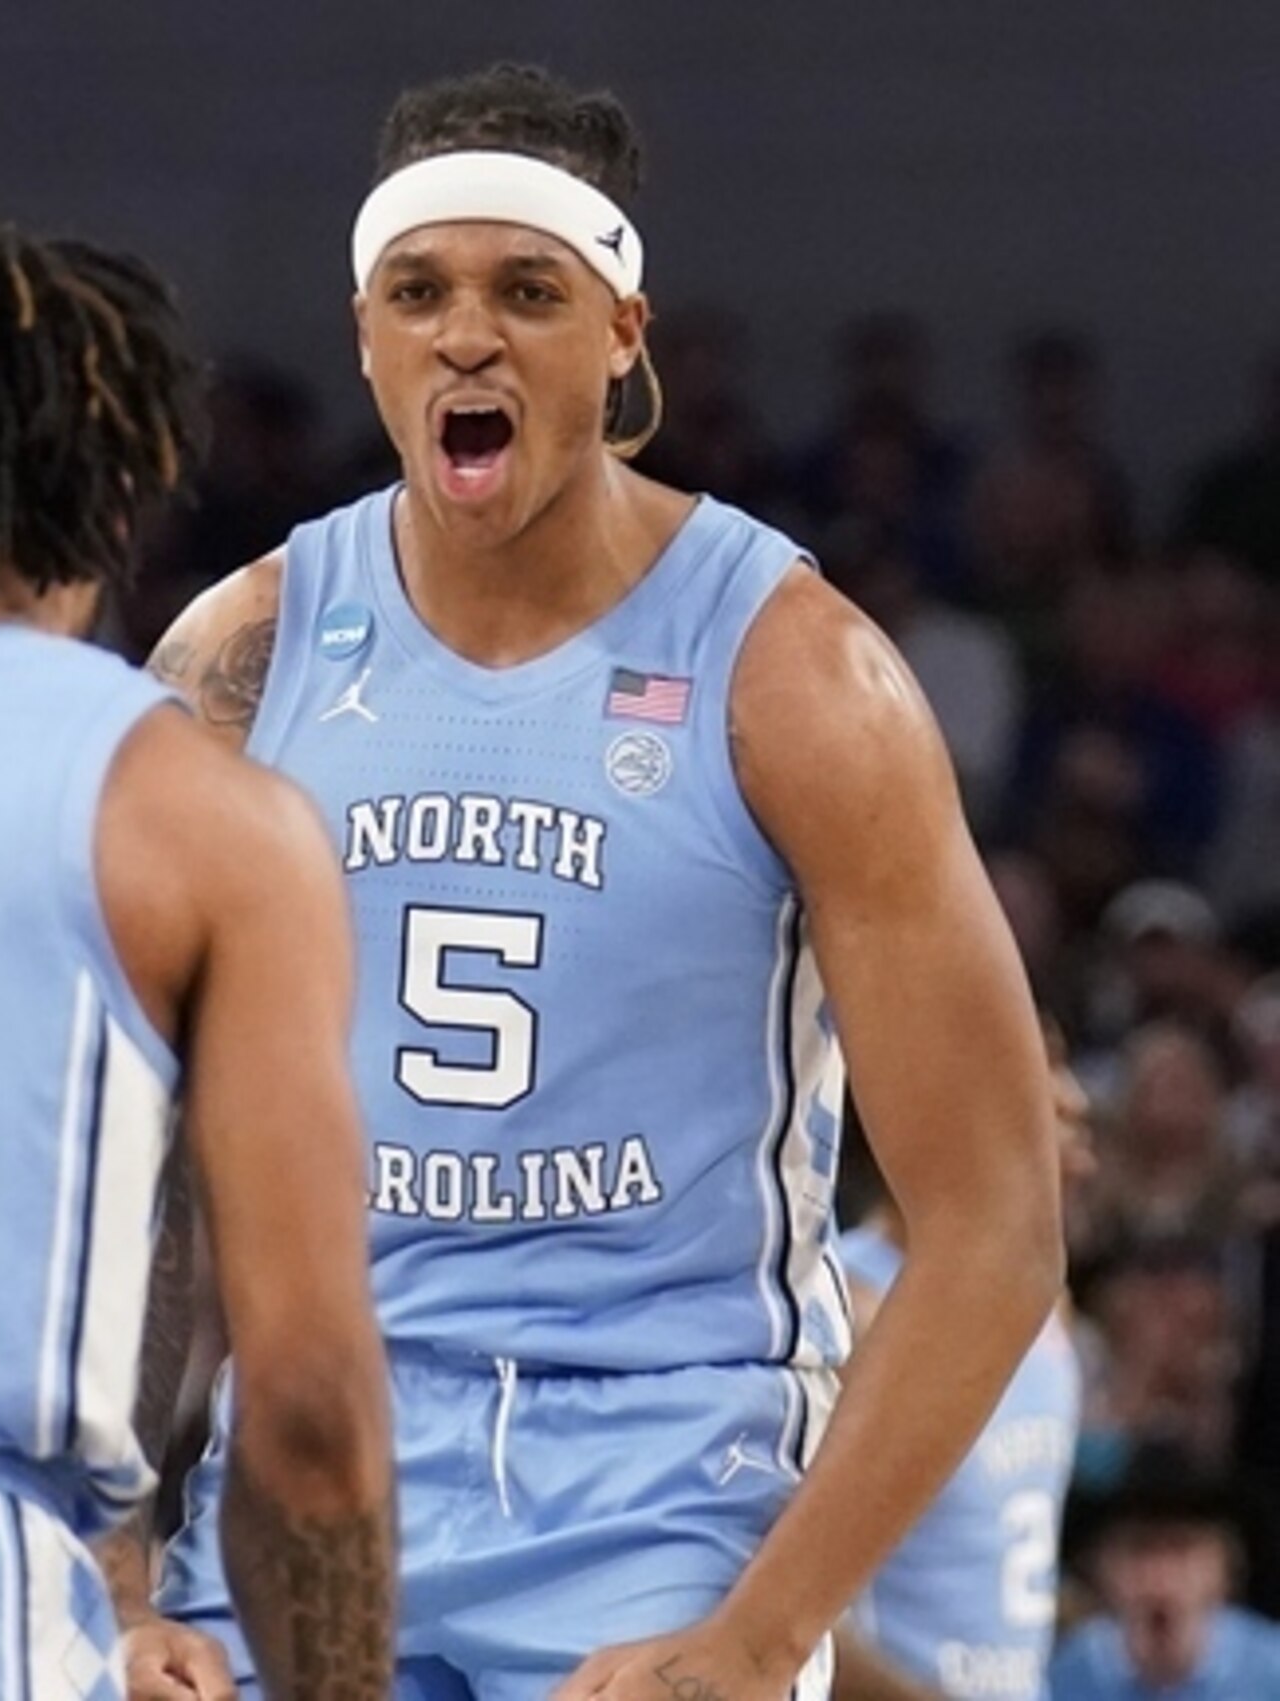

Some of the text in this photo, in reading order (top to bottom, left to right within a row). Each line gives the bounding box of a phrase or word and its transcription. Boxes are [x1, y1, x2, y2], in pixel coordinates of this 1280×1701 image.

[345, 791, 607, 889] NORTH
[395, 903, 545, 1111] 5
[366, 1134, 662, 1223] ROLINA
[999, 1488, 1060, 1628] 2
